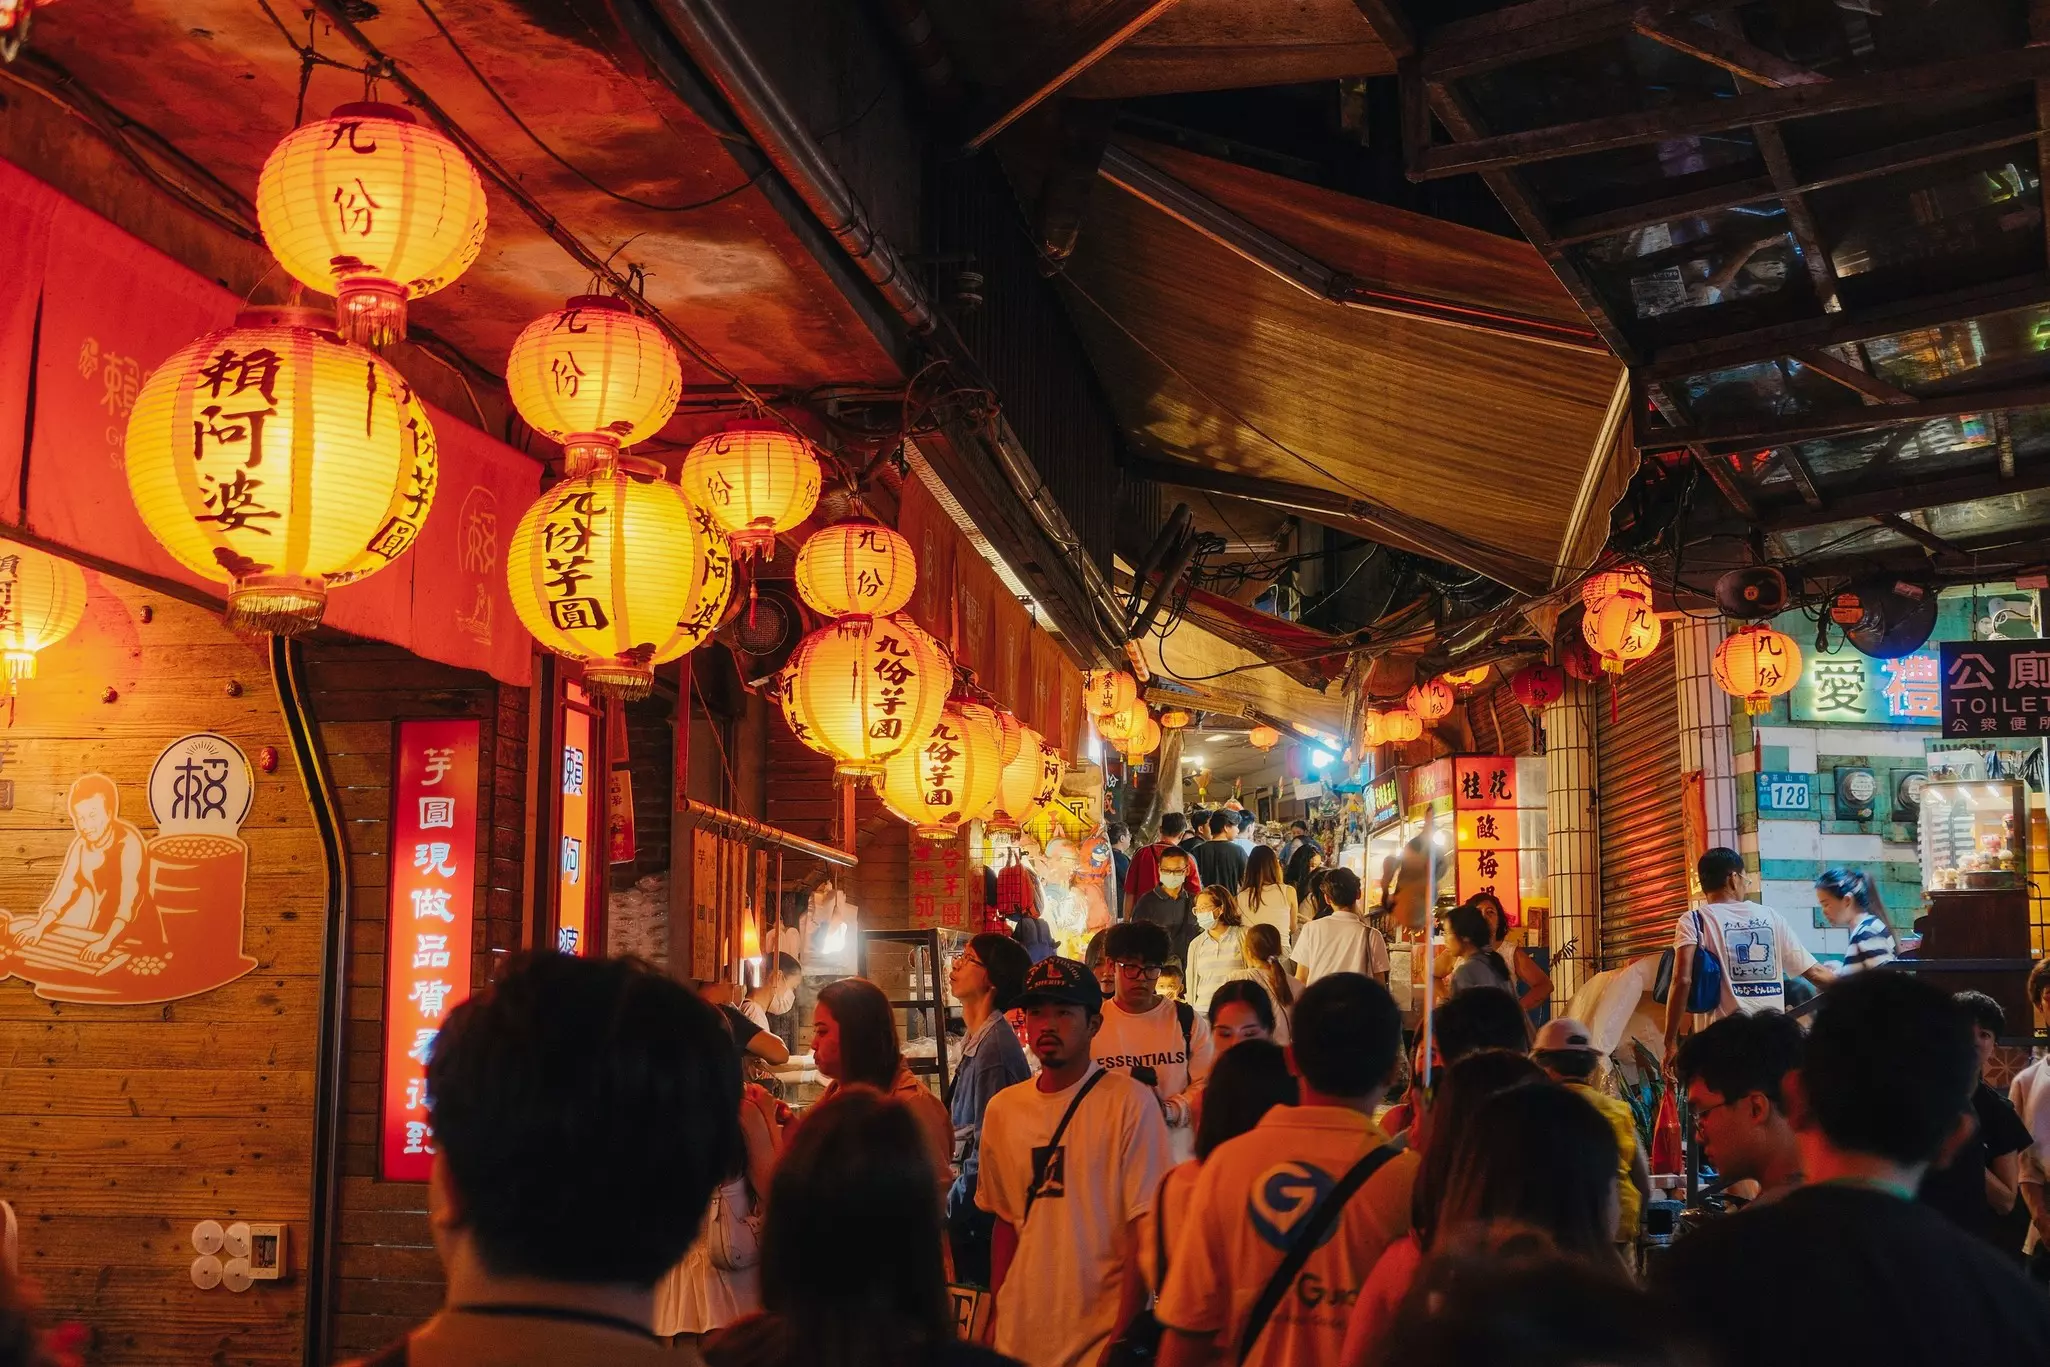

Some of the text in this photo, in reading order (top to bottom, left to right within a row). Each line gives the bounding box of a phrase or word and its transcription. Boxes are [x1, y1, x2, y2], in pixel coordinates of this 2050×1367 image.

[327, 121, 382, 238] 九份
[551, 309, 588, 398] 九份
[704, 434, 734, 506] 九份
[541, 491, 609, 631] 九份芋圓
[857, 529, 887, 597] 九份
[869, 634, 915, 740] 九份芋圓
[1758, 635, 1783, 687] 九份
[1950, 696, 2050, 714] TOILET
[924, 723, 960, 806] 九份芋圓
[1461, 769, 1512, 800] 桂花
[1774, 785, 1806, 806] 128
[1097, 1051, 1185, 1070] ESSENTIALS
